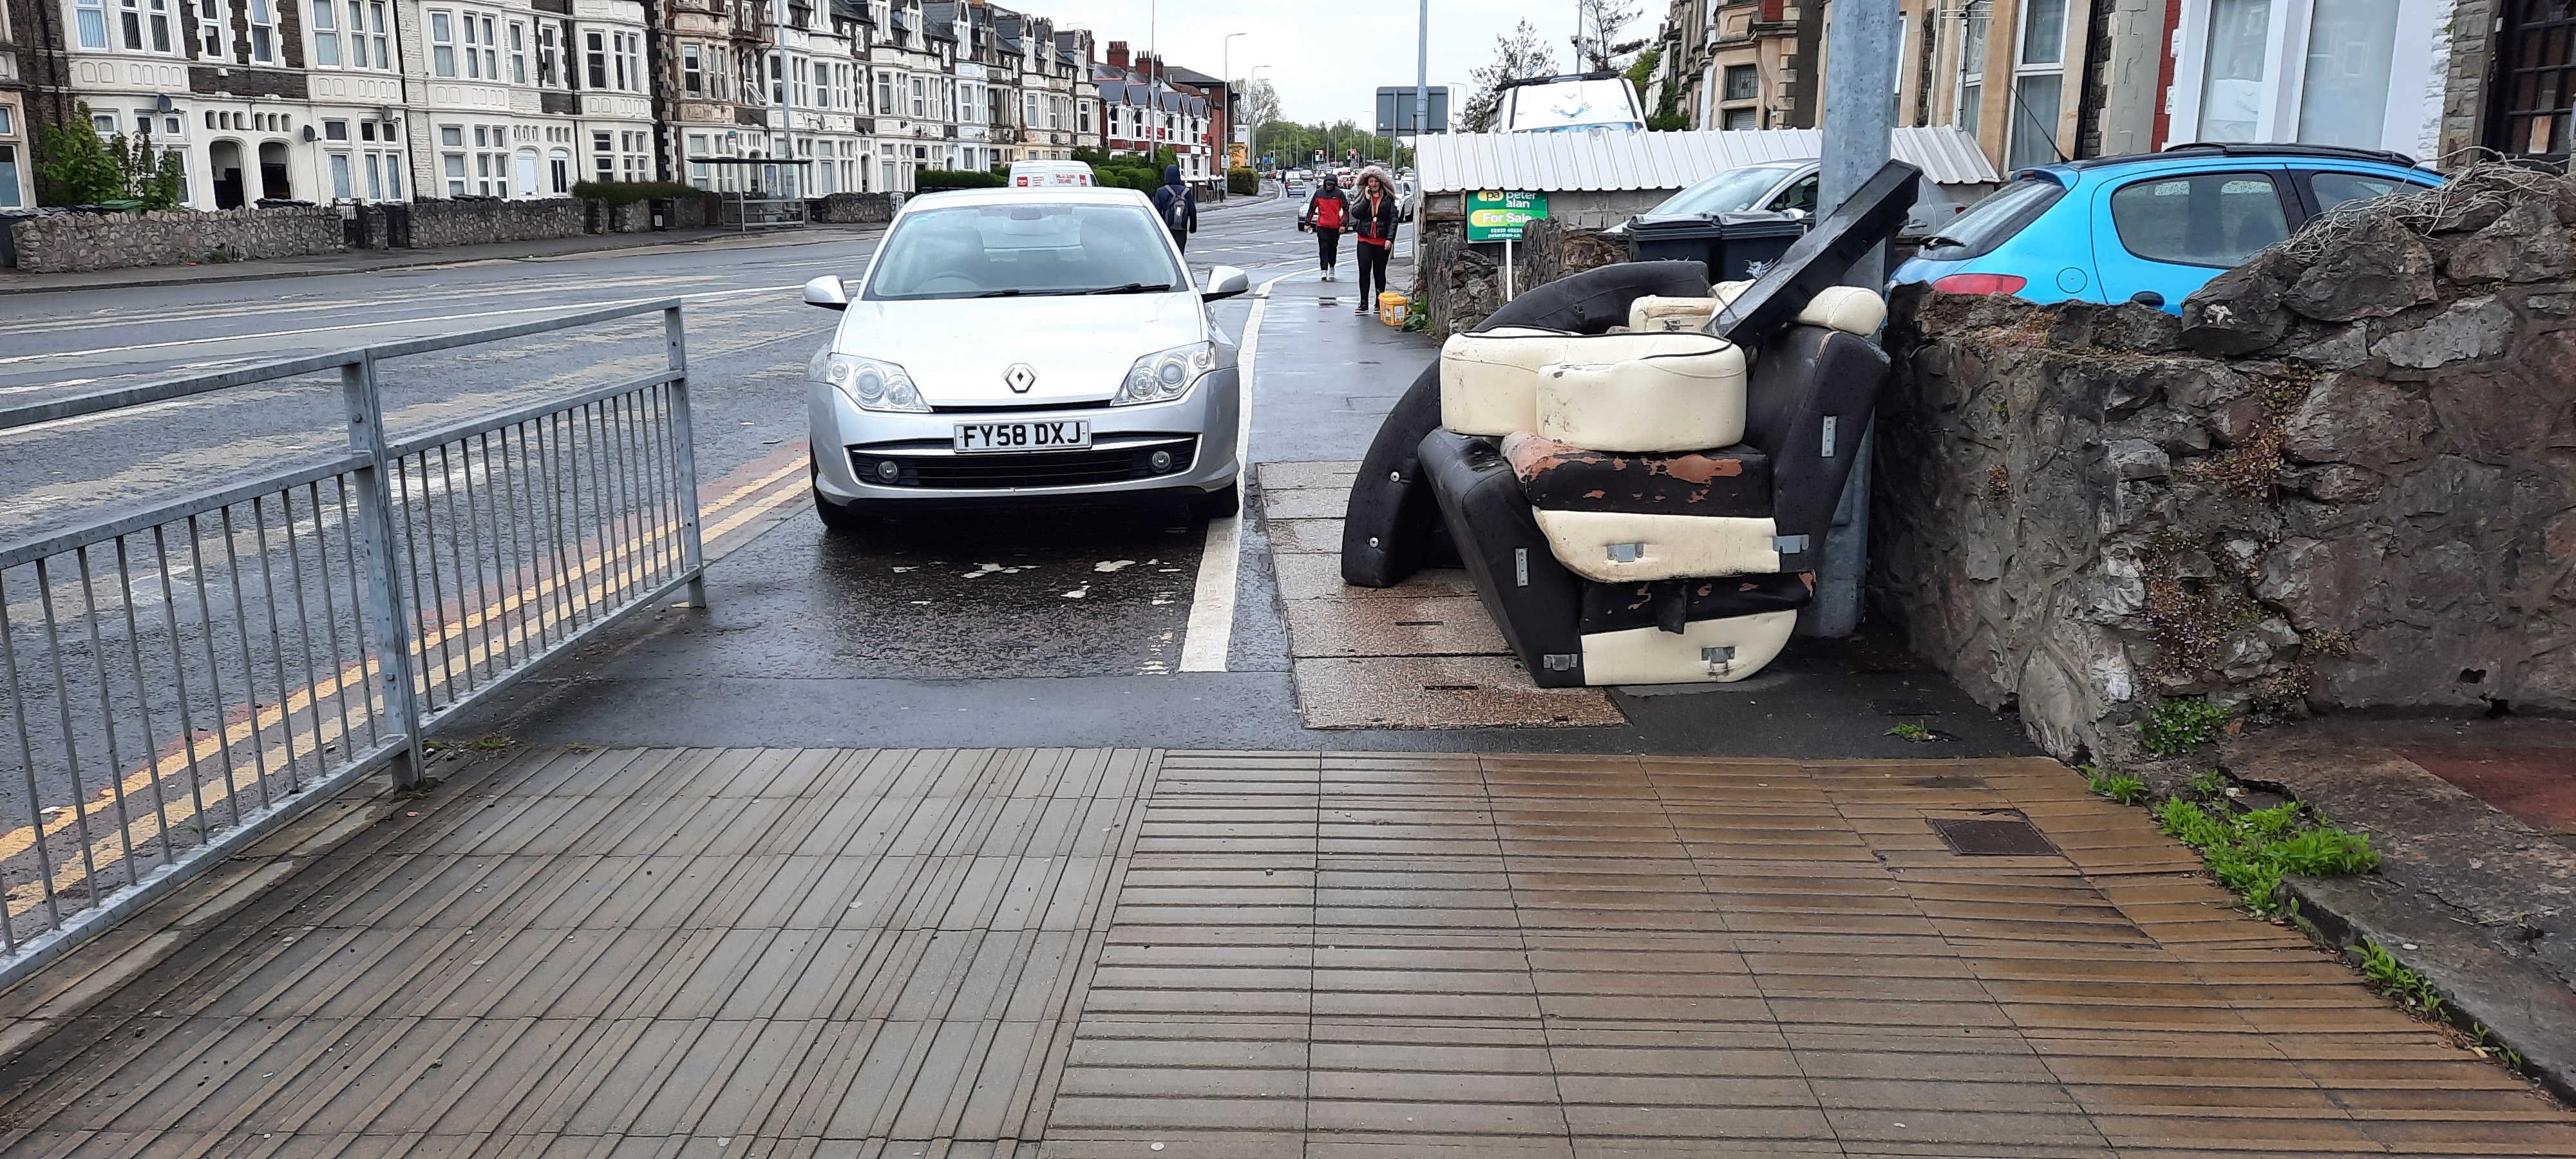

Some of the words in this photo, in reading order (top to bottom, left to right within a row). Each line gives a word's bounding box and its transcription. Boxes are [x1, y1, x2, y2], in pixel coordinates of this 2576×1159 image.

[1486, 191, 1500, 201] pa
[1506, 191, 1537, 201] peter
[1506, 198, 1530, 208] alan
[1482, 212, 1504, 223] For
[1506, 212, 1533, 223] Sale
[963, 424, 1027, 448] FY58
[1034, 422, 1081, 445] DXJ
